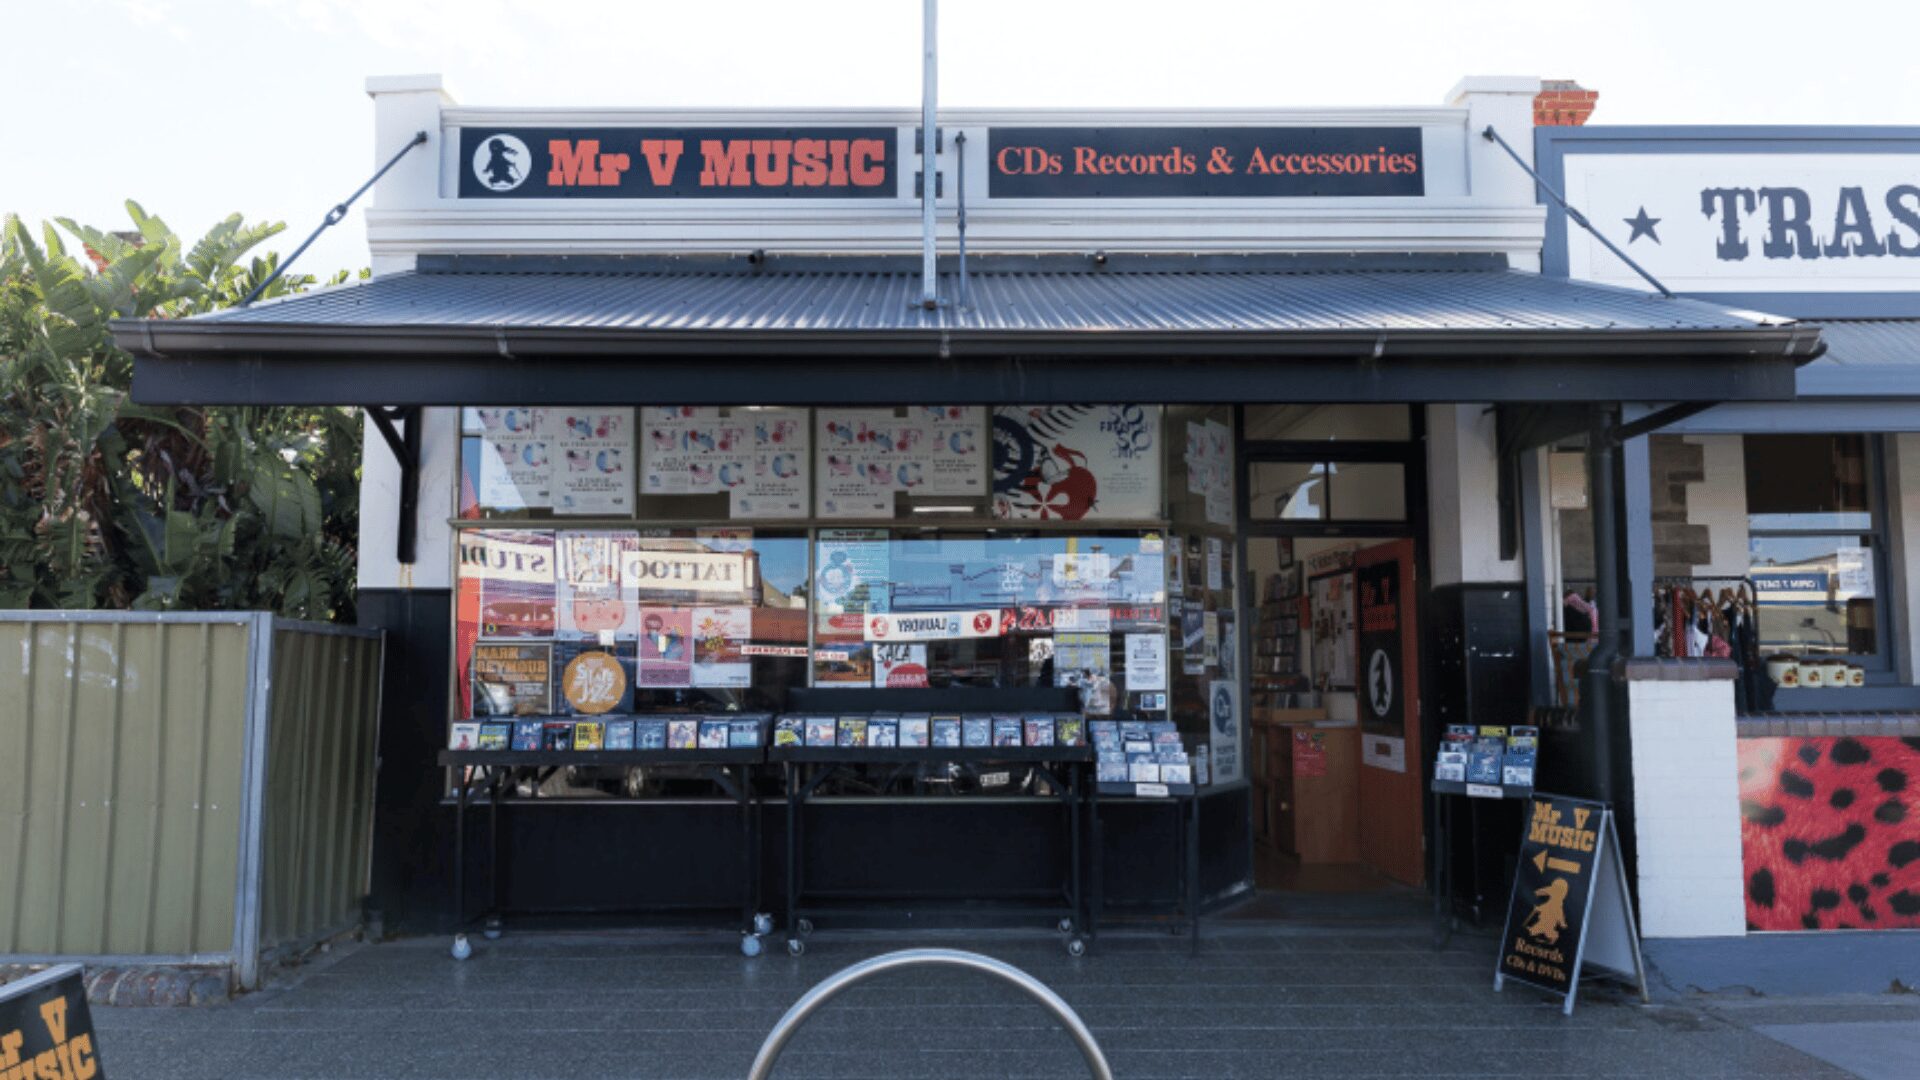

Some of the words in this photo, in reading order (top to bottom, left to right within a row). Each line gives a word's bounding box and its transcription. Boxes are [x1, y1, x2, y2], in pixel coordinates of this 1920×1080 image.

[548, 139, 630, 186] Mr
[641, 139, 684, 186] V
[700, 138, 885, 187] MUSIC
[997, 146, 1063, 176] CDs
[1073, 146, 1197, 176] Records
[1206, 146, 1236, 176] &
[1247, 145, 1418, 176] Accessories
[1532, 801, 1561, 825] Mr
[1574, 807, 1590, 829] V
[1529, 821, 1596, 852] MUSIC
[1515, 937, 1564, 963] Records
[0, 1028, 23, 1070] r
[40, 995, 67, 1045] V
